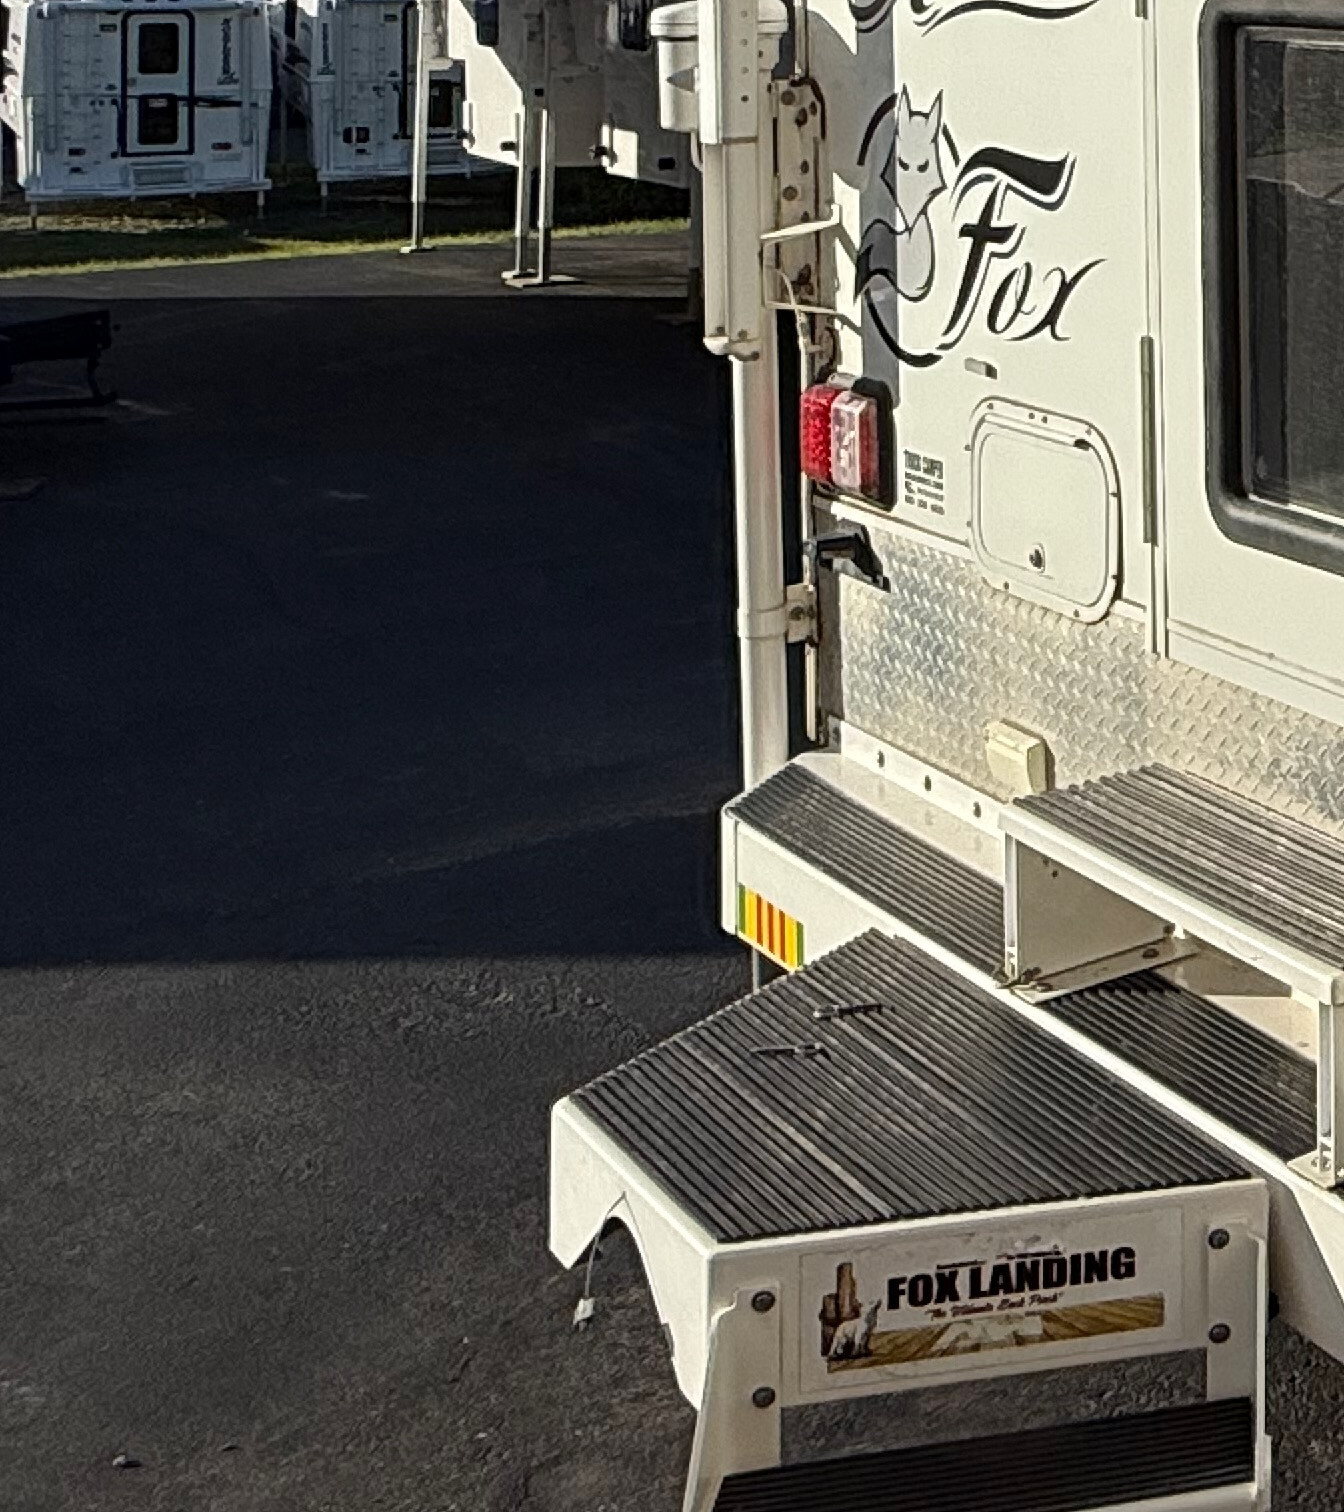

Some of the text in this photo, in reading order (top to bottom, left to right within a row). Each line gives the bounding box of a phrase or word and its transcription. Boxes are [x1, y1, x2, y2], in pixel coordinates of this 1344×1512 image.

[938, 145, 1107, 351] Fox
[886, 1268, 960, 1312] FOX
[968, 1246, 1136, 1300] LANDING
